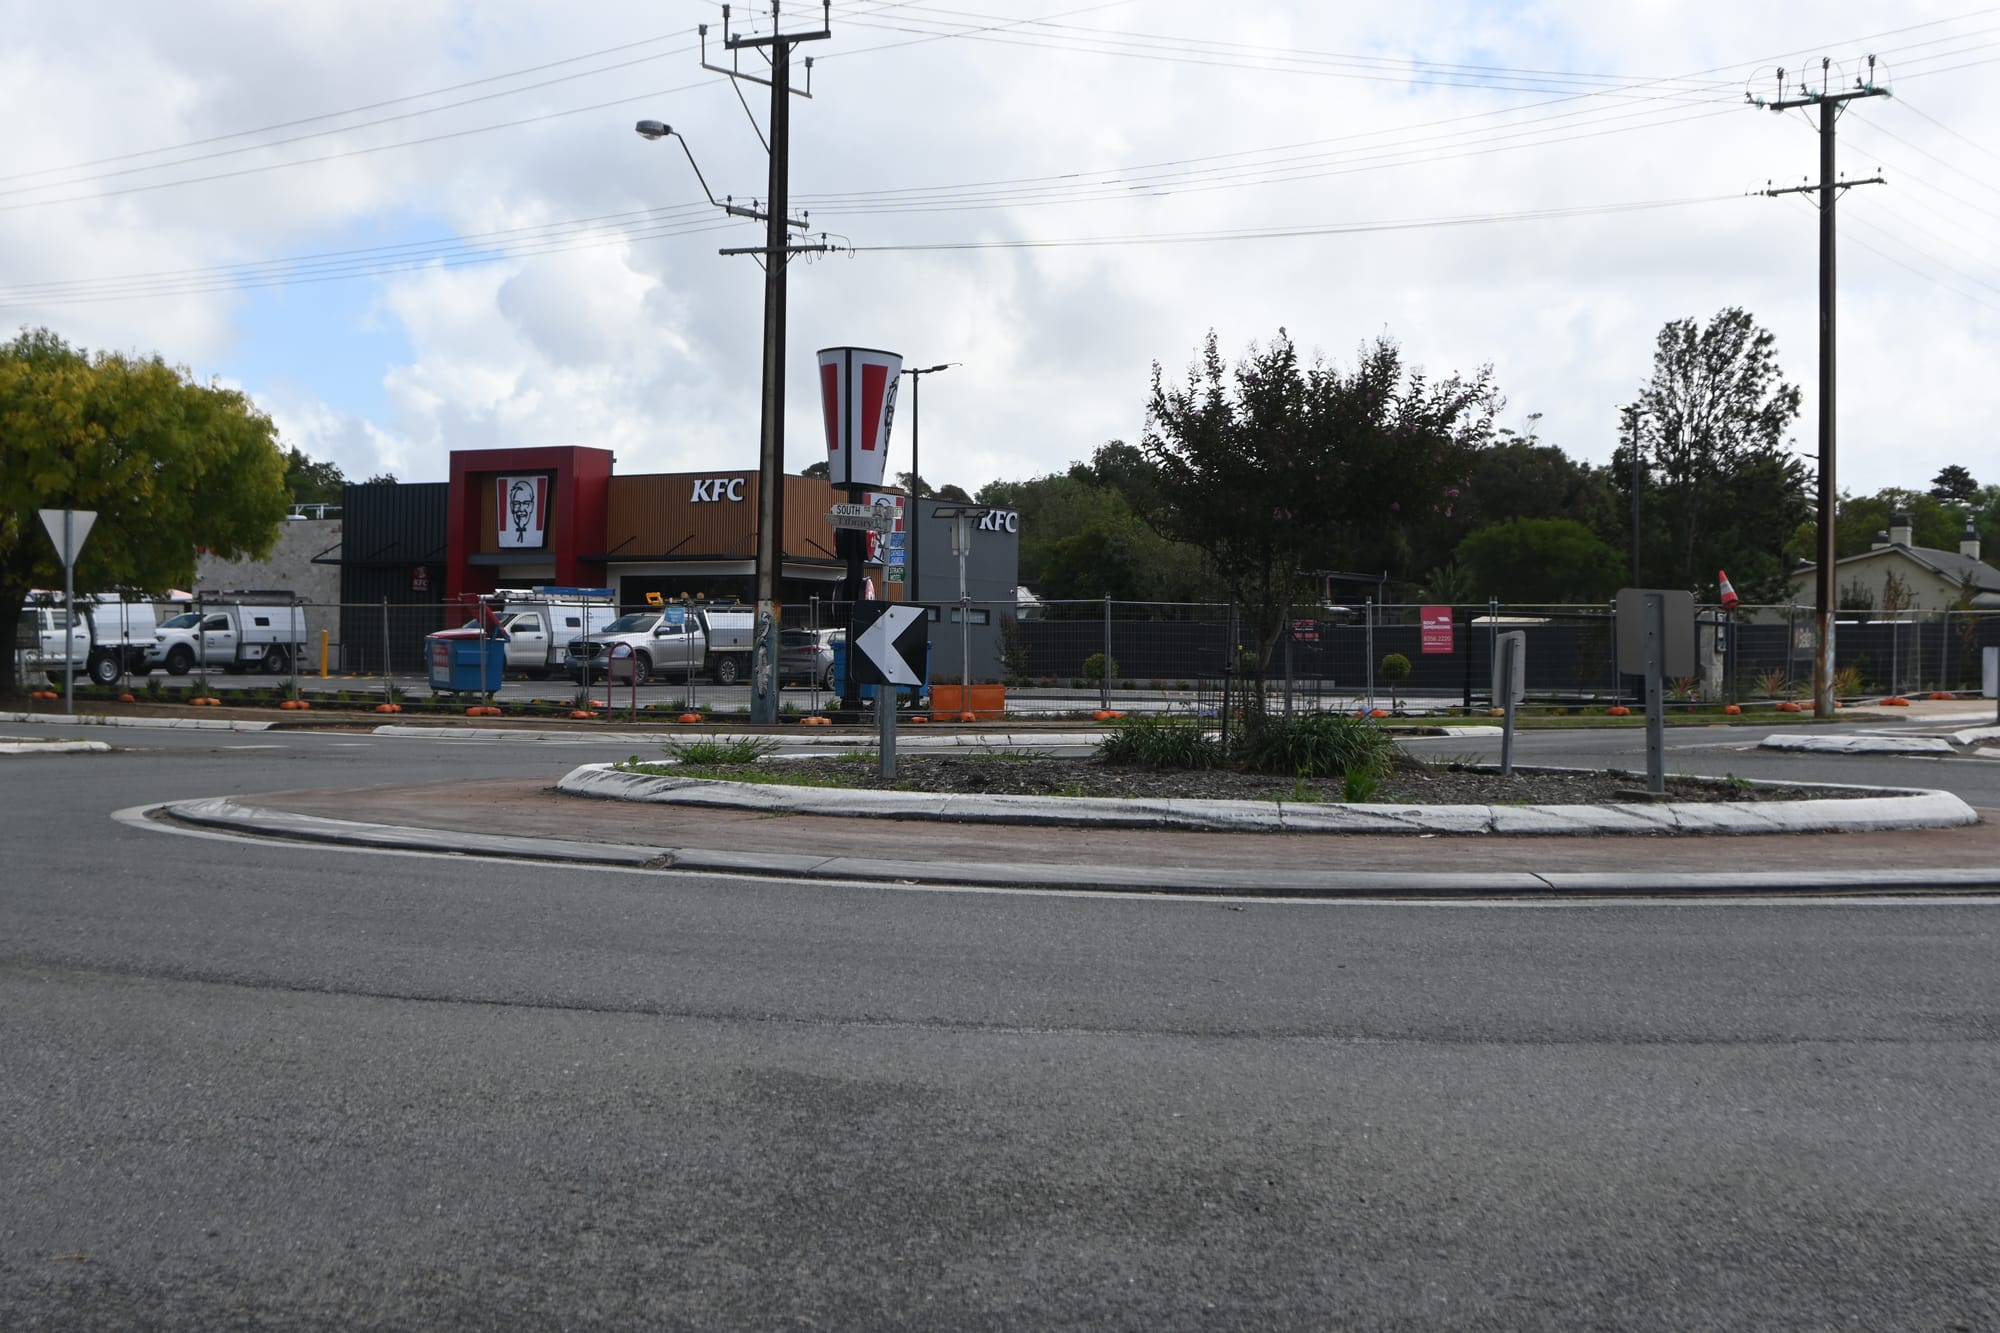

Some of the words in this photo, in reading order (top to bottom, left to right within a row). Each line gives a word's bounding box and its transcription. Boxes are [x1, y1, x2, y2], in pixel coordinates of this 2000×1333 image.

[690, 478, 745, 503] KFC
[836, 505, 861, 515] SOUTH
[979, 510, 1018, 533] KFC
